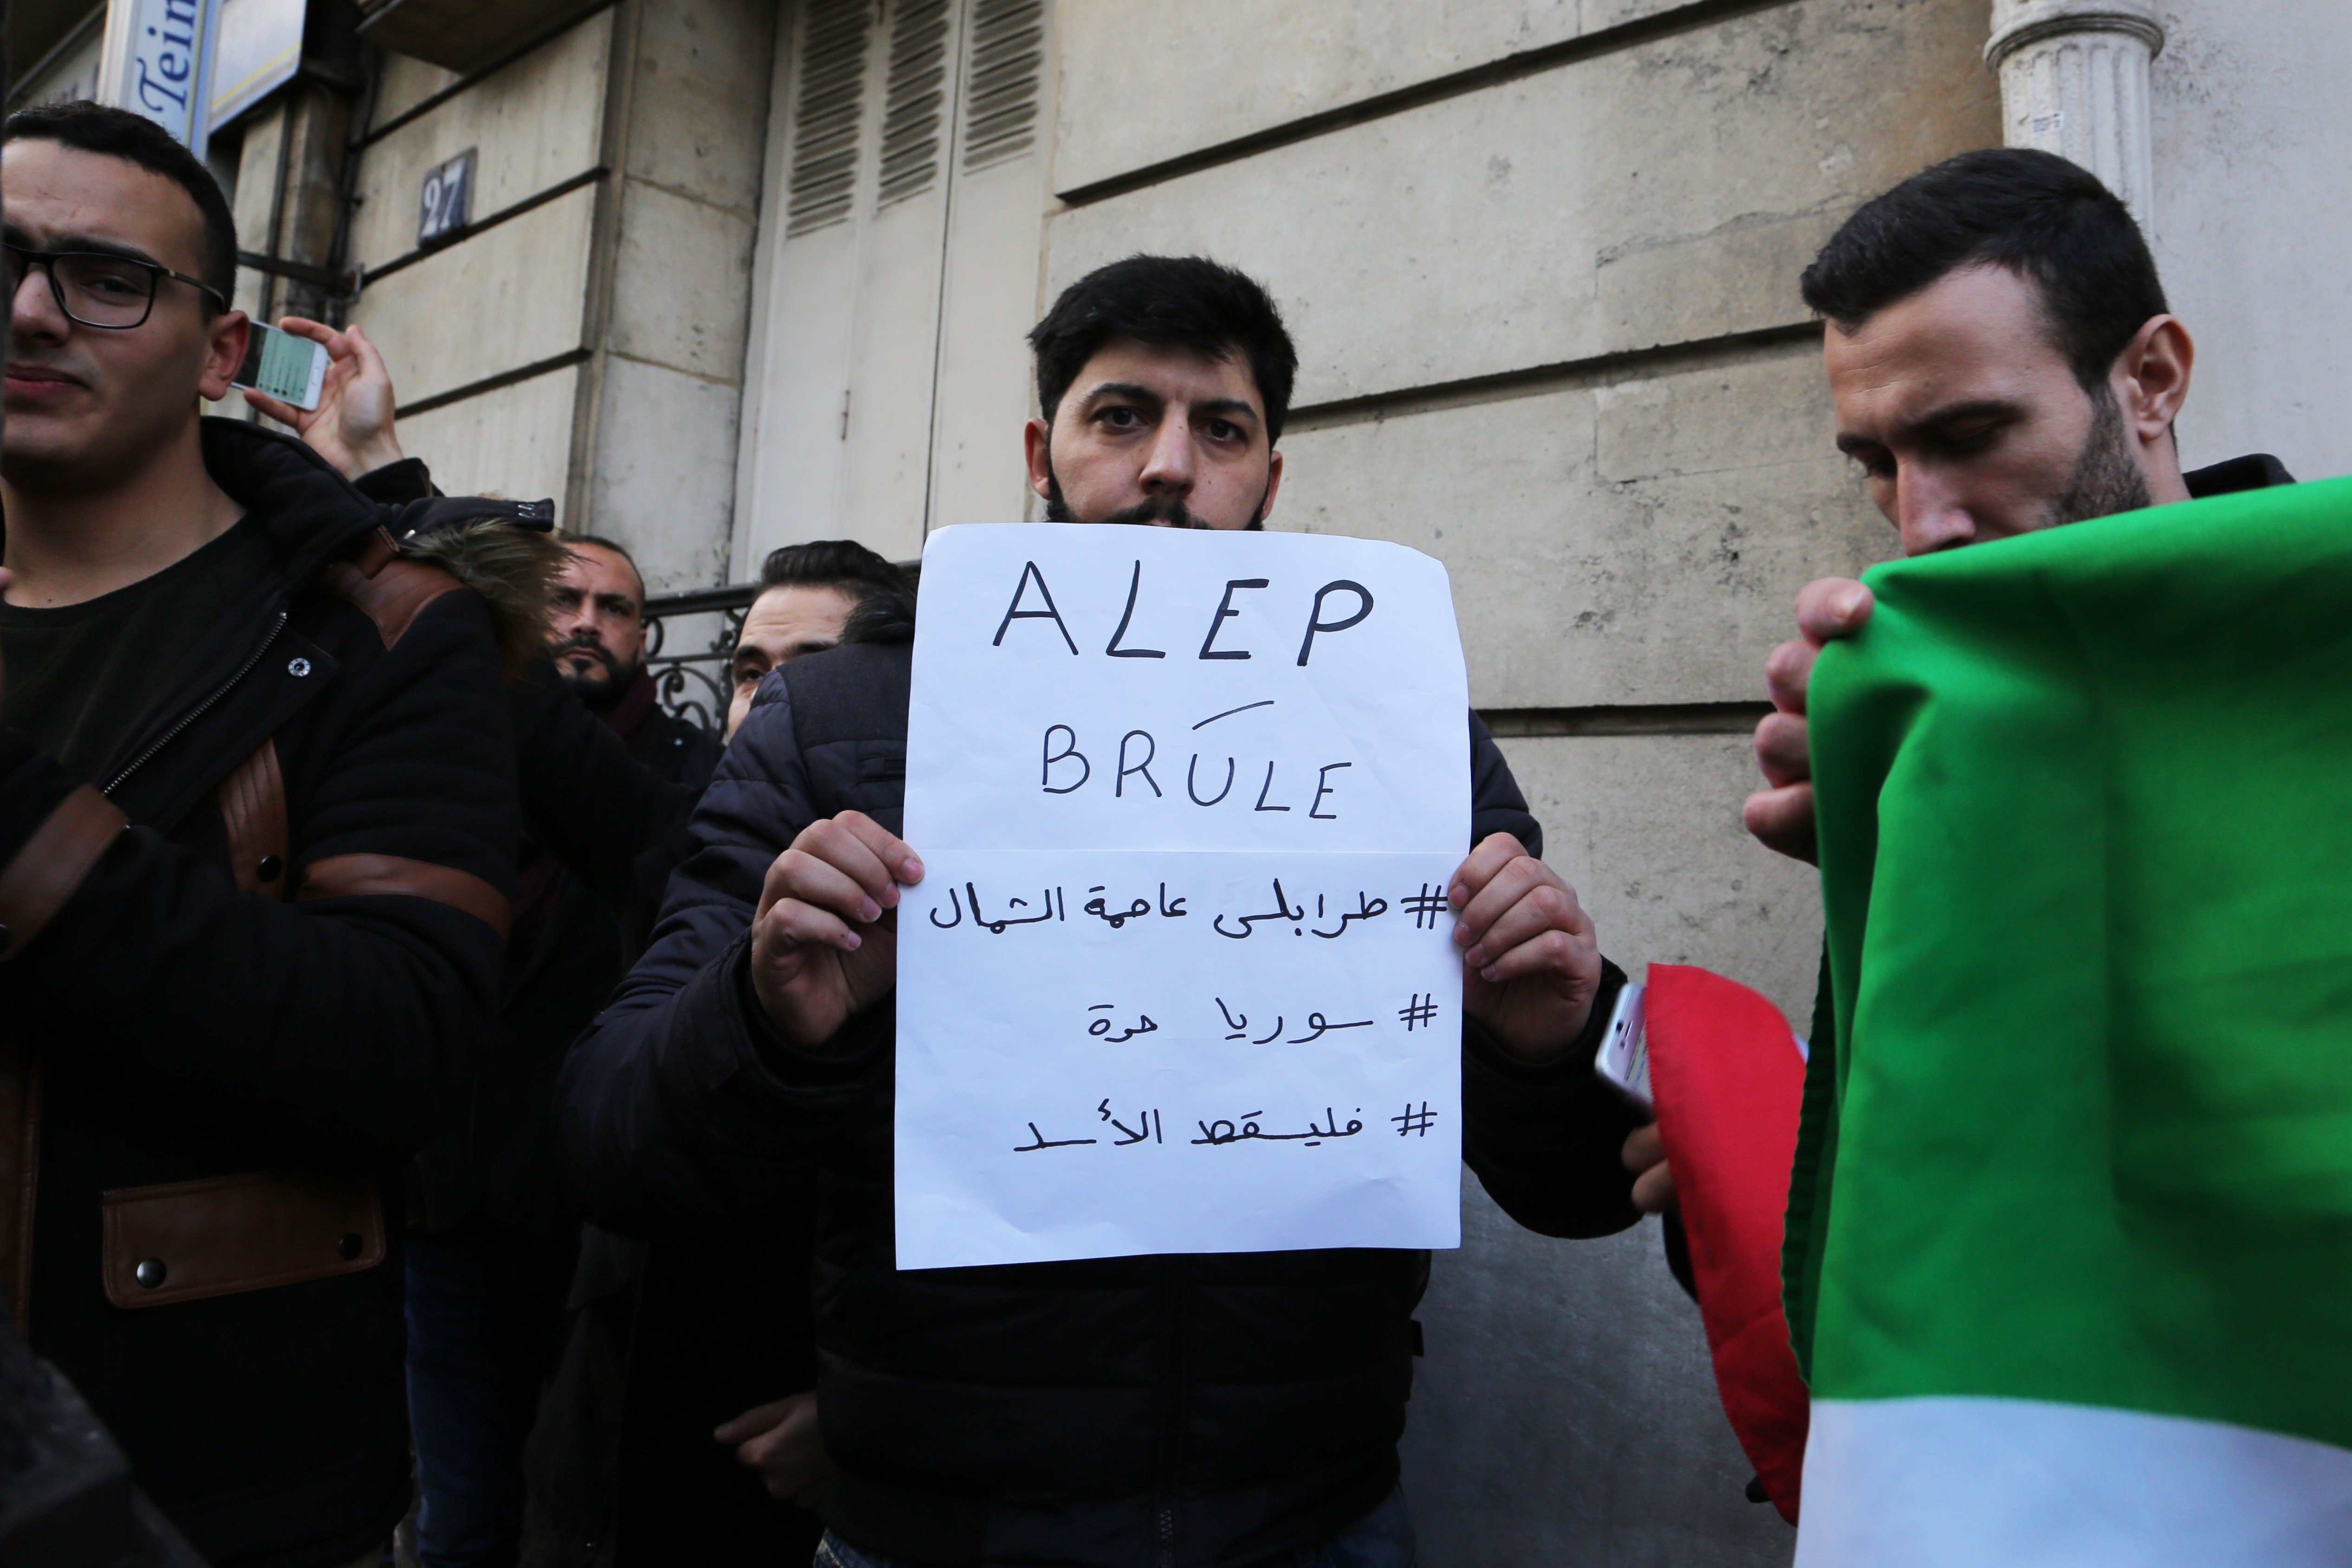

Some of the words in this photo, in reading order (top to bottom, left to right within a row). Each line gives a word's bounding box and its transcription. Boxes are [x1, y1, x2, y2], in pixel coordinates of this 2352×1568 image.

[421, 160, 466, 236] 27
[992, 559, 1374, 667] ALEP
[929, 881, 1065, 935] الشمال
[1083, 881, 1187, 929] عاصمة
[1088, 1004, 1158, 1043] حرة
[1013, 1098, 1163, 1152] الأسد
